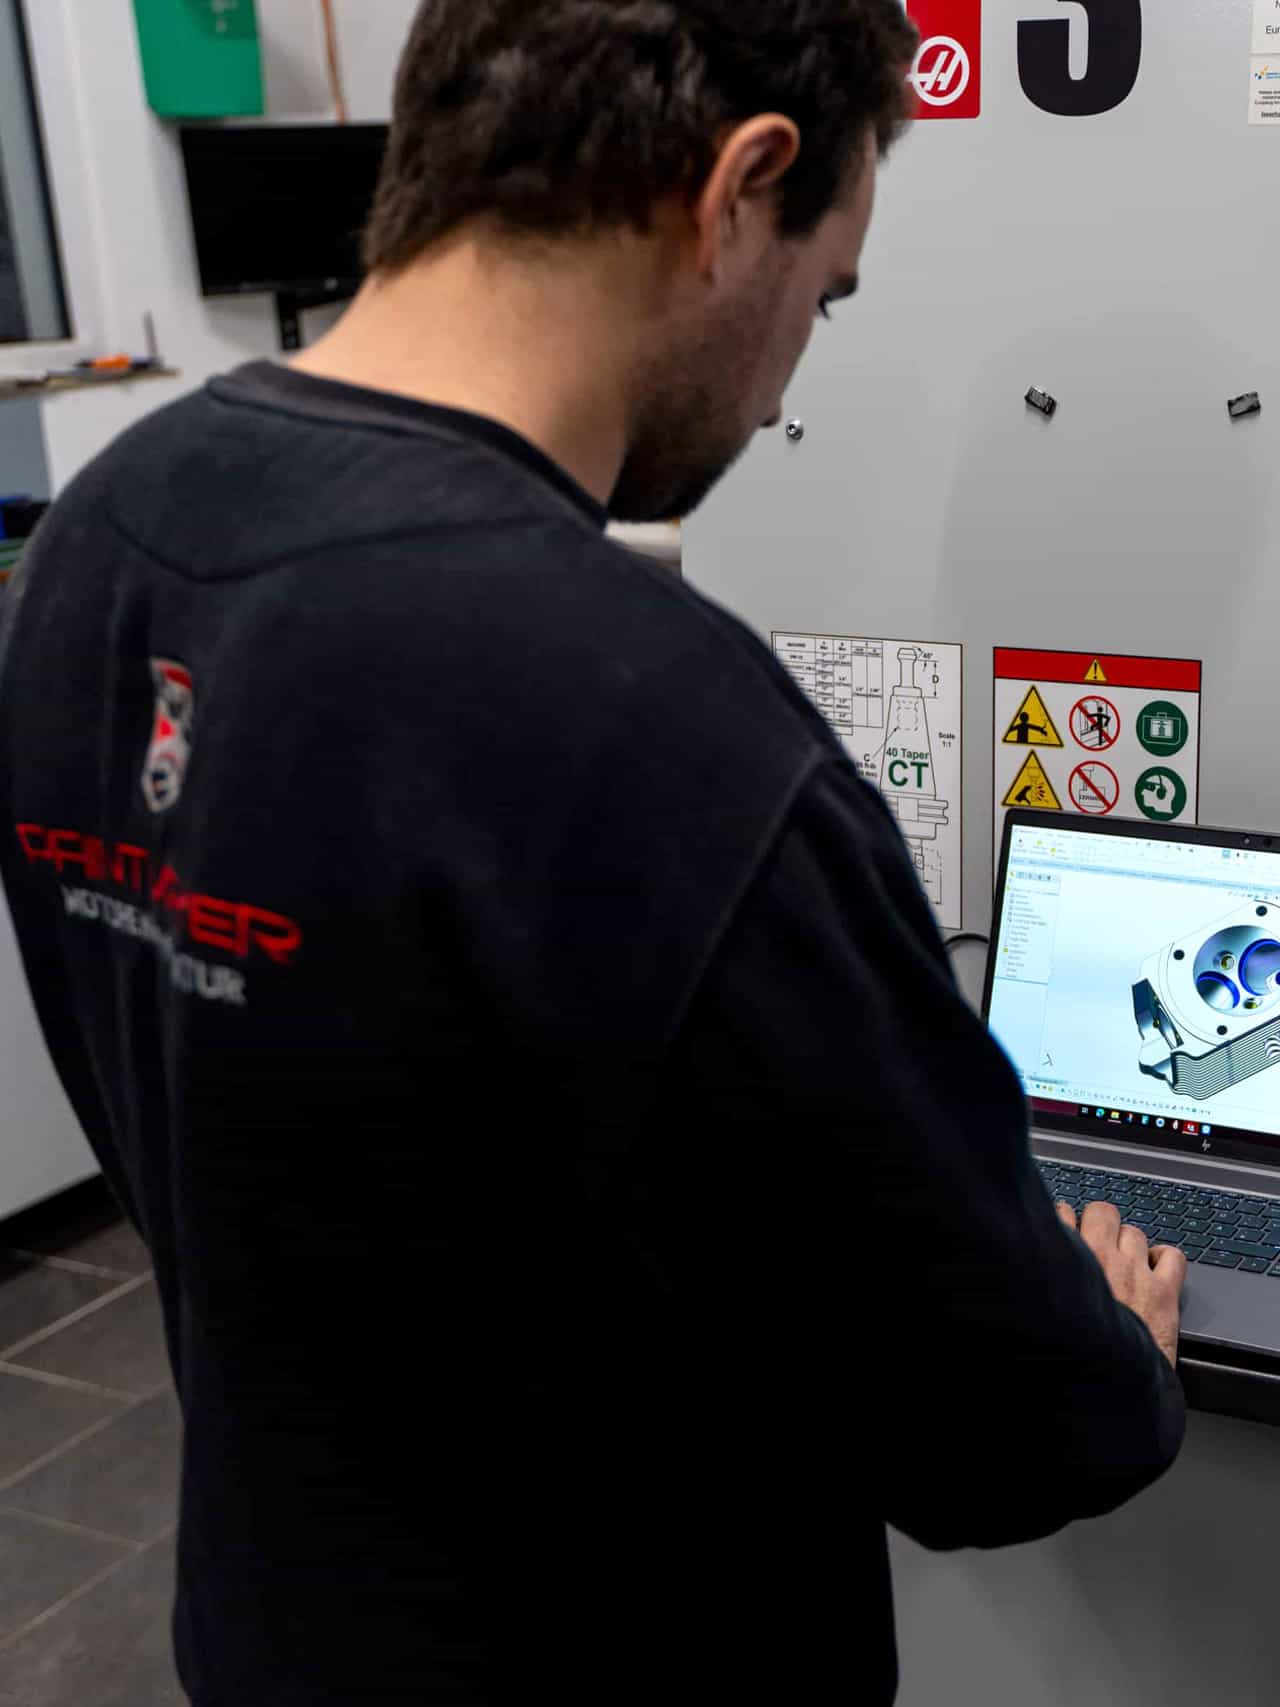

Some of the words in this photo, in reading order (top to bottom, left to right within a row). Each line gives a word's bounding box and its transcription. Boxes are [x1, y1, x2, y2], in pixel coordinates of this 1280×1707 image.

[932, 674, 940, 684] D
[938, 731, 956, 740] Scale
[863, 753, 870, 762] C
[886, 747, 898, 758] 40
[900, 748, 929, 760] Taper
[888, 759, 929, 789] CT
